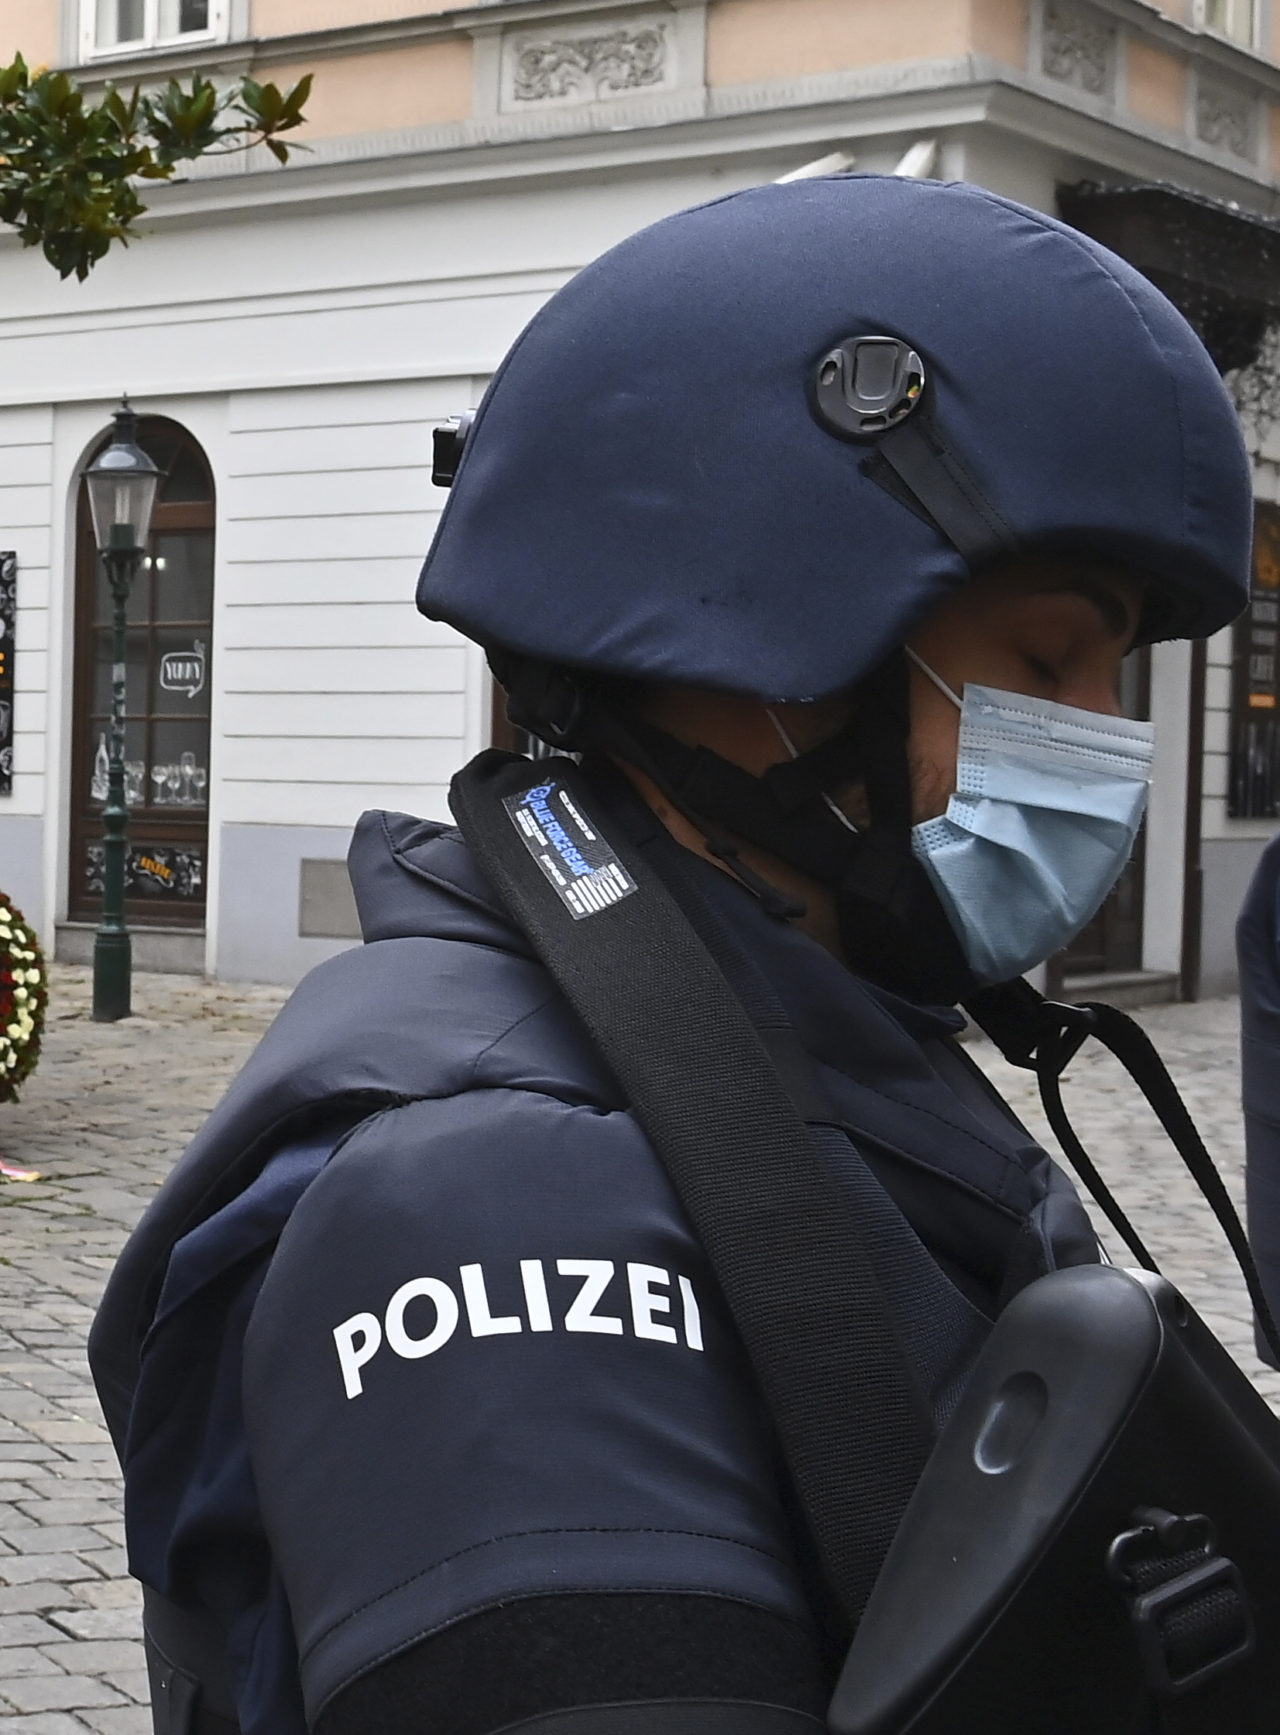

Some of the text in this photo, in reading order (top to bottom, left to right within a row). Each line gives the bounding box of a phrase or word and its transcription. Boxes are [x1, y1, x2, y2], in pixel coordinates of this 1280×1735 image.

[529, 799, 553, 825] BLUE
[543, 819, 575, 853] FORCE
[560, 844, 590, 877] GEAR
[333, 1258, 704, 1400] POLIZEI
